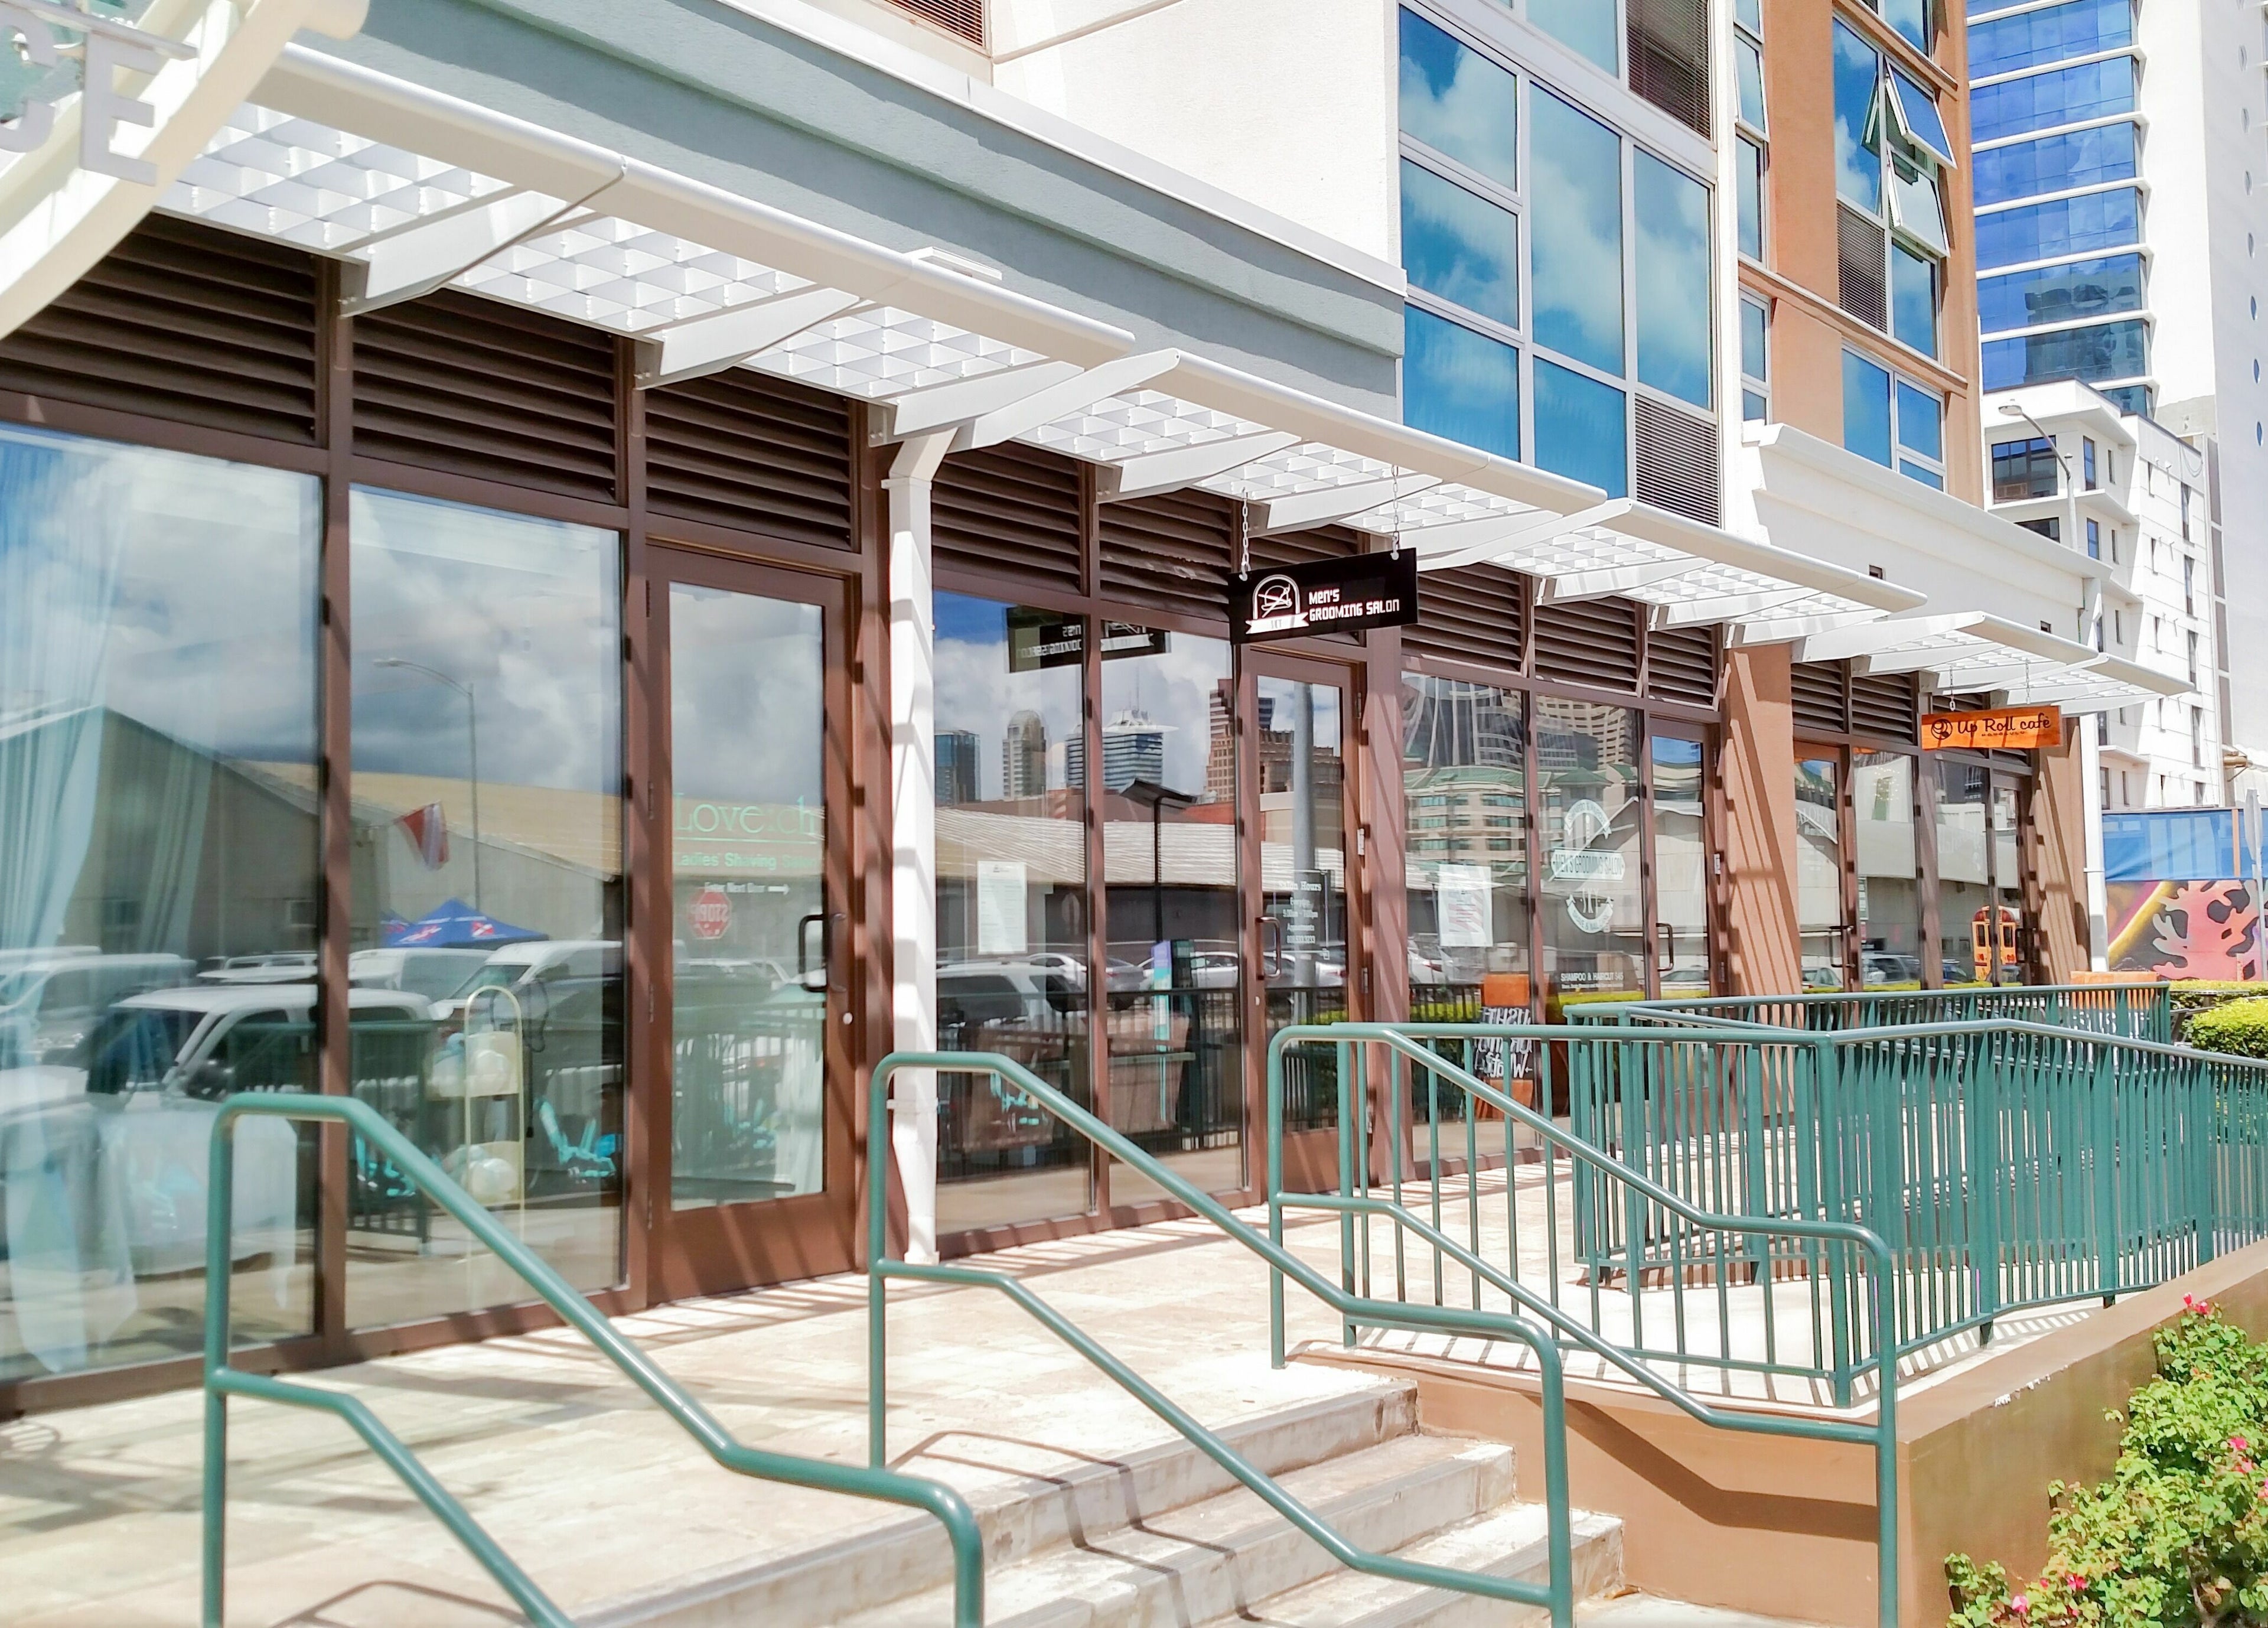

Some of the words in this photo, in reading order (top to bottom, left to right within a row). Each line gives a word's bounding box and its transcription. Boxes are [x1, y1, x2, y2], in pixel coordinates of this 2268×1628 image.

[1309, 603, 1363, 621] GROOMING
[1366, 598, 1400, 614] SALON
[1957, 720, 1978, 736] Up
[1982, 716, 2016, 732] Roll
[724, 852, 777, 871] Shaving
[1300, 880, 1322, 891] Hours
[1560, 972, 1586, 982] SHAMPOO
